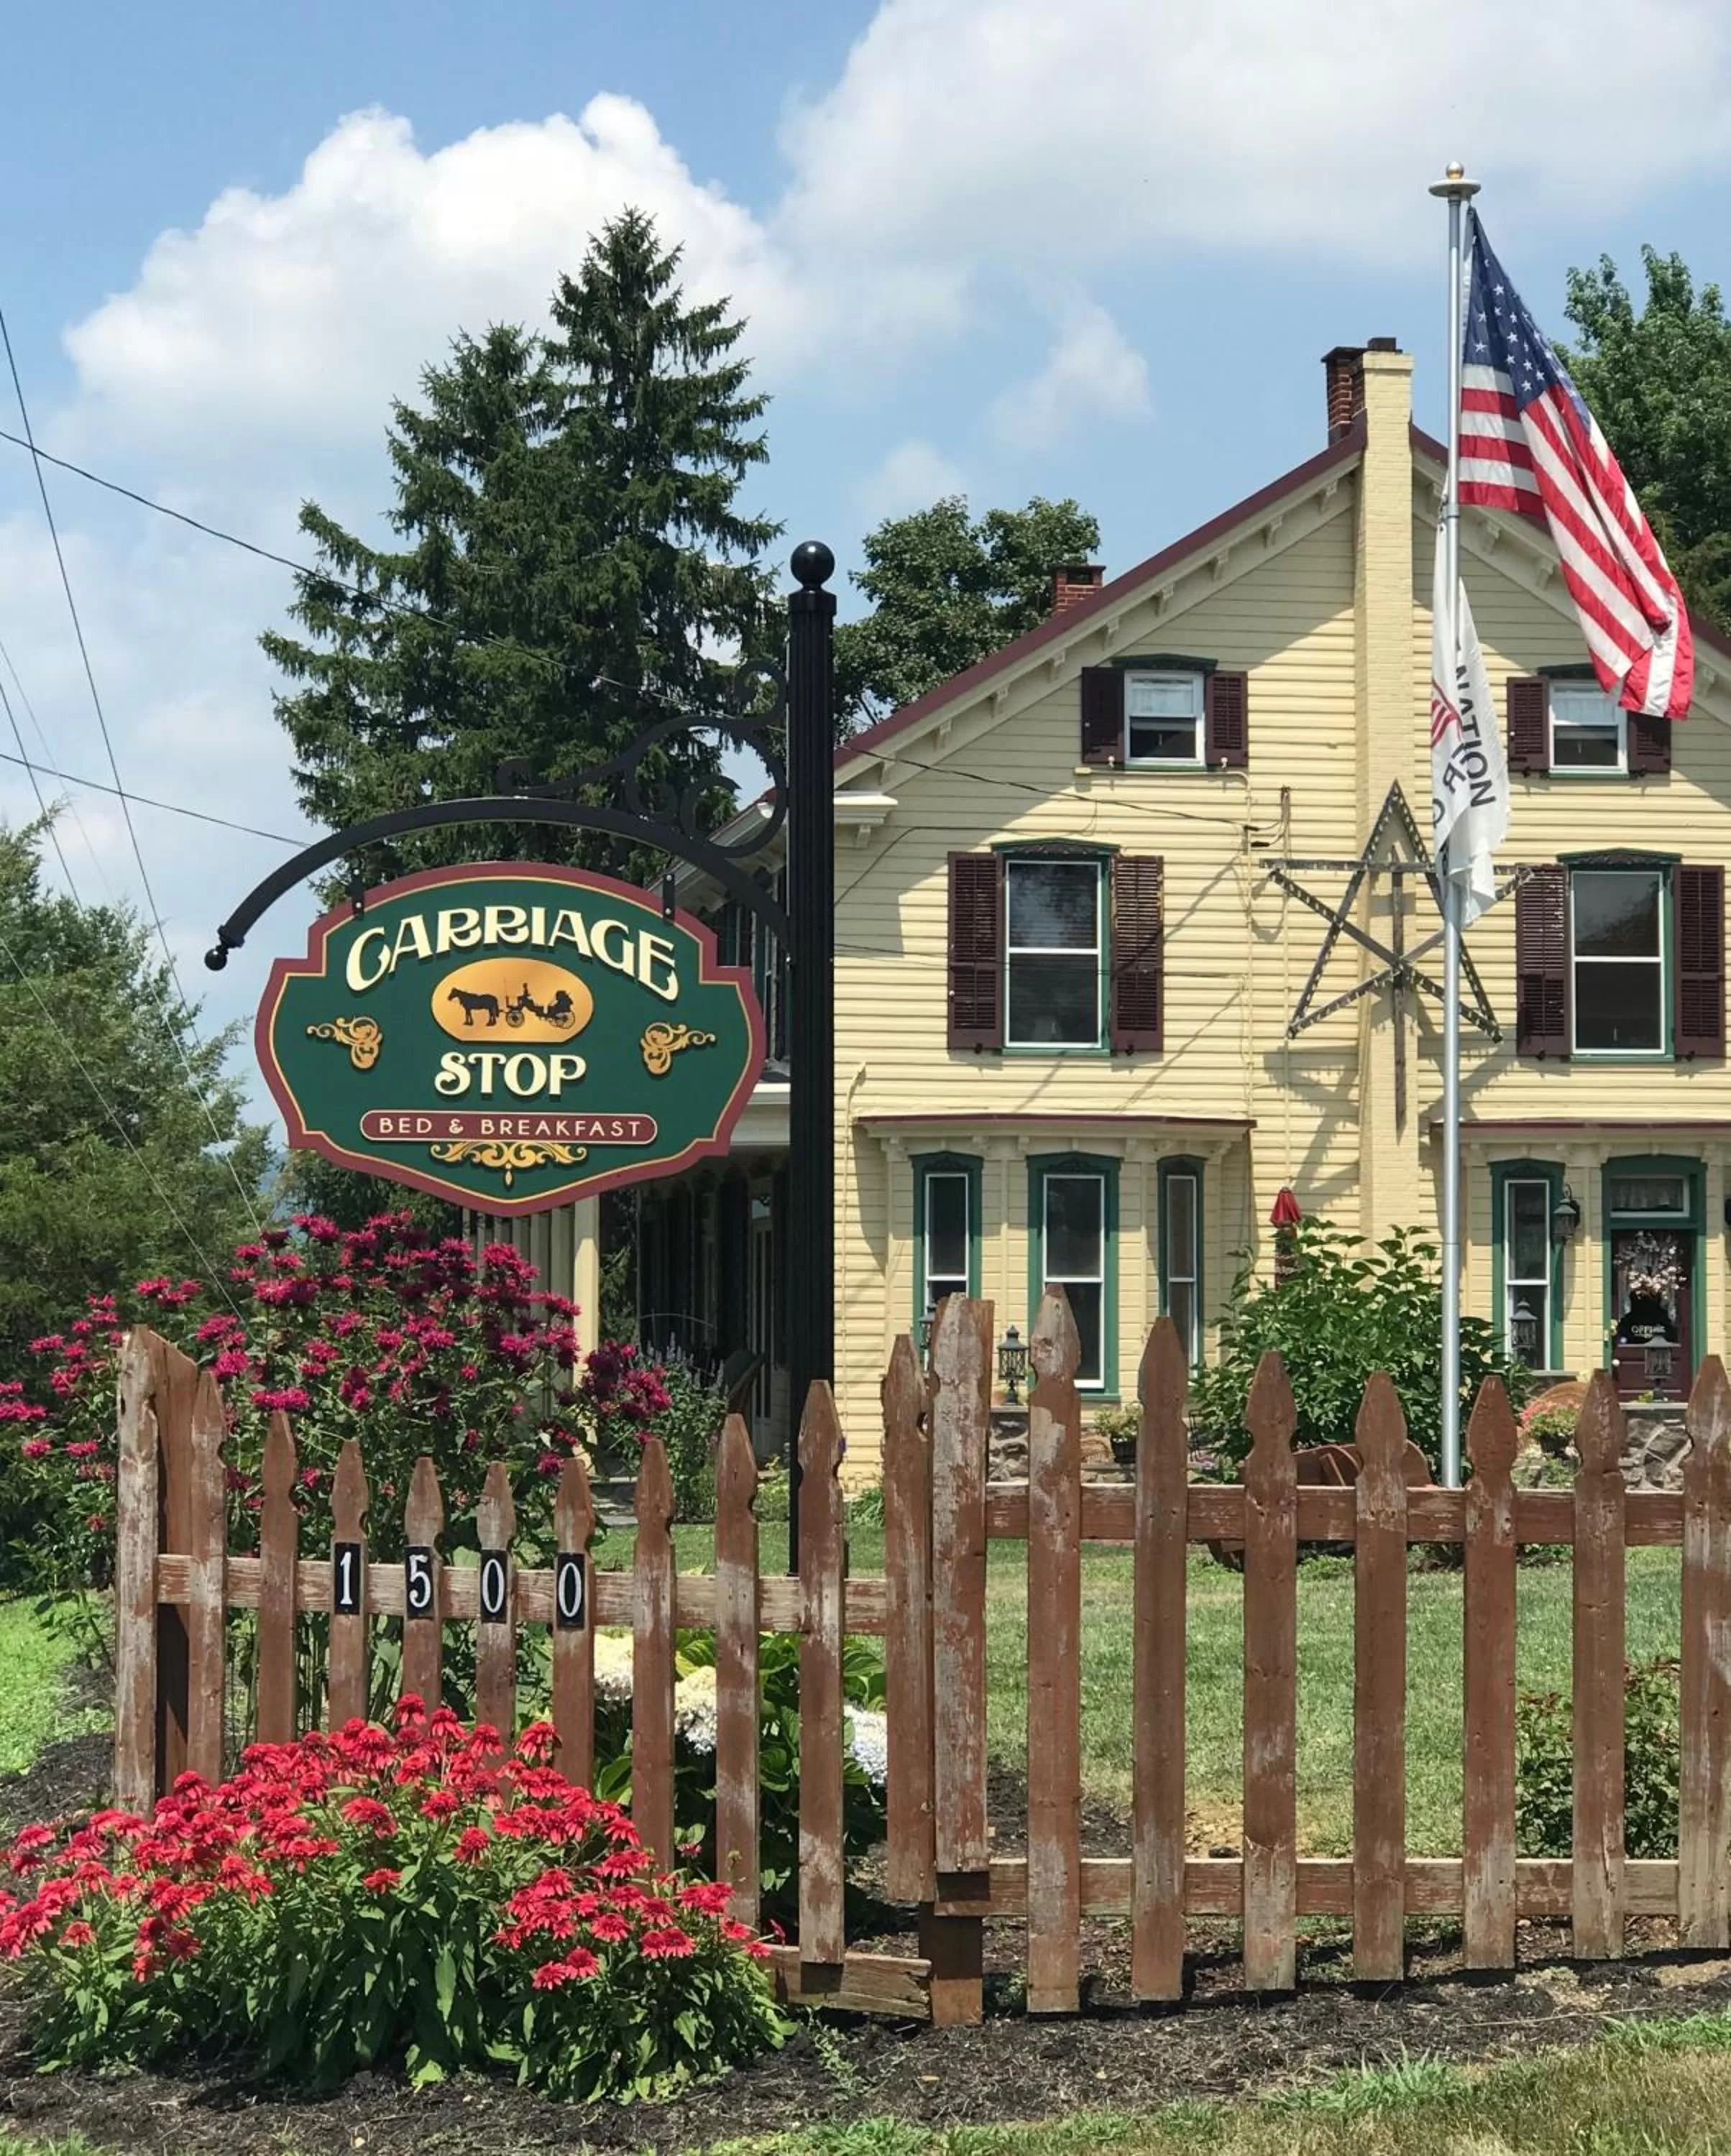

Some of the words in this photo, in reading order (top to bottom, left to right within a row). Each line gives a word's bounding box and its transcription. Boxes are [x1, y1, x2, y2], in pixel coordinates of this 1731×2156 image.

[345, 906, 679, 1001] CARRIAGE
[434, 1051, 587, 1096] STOP
[379, 1118, 432, 1133] BED
[449, 1118, 464, 1135] &
[481, 1118, 641, 1138] BREAKFAST
